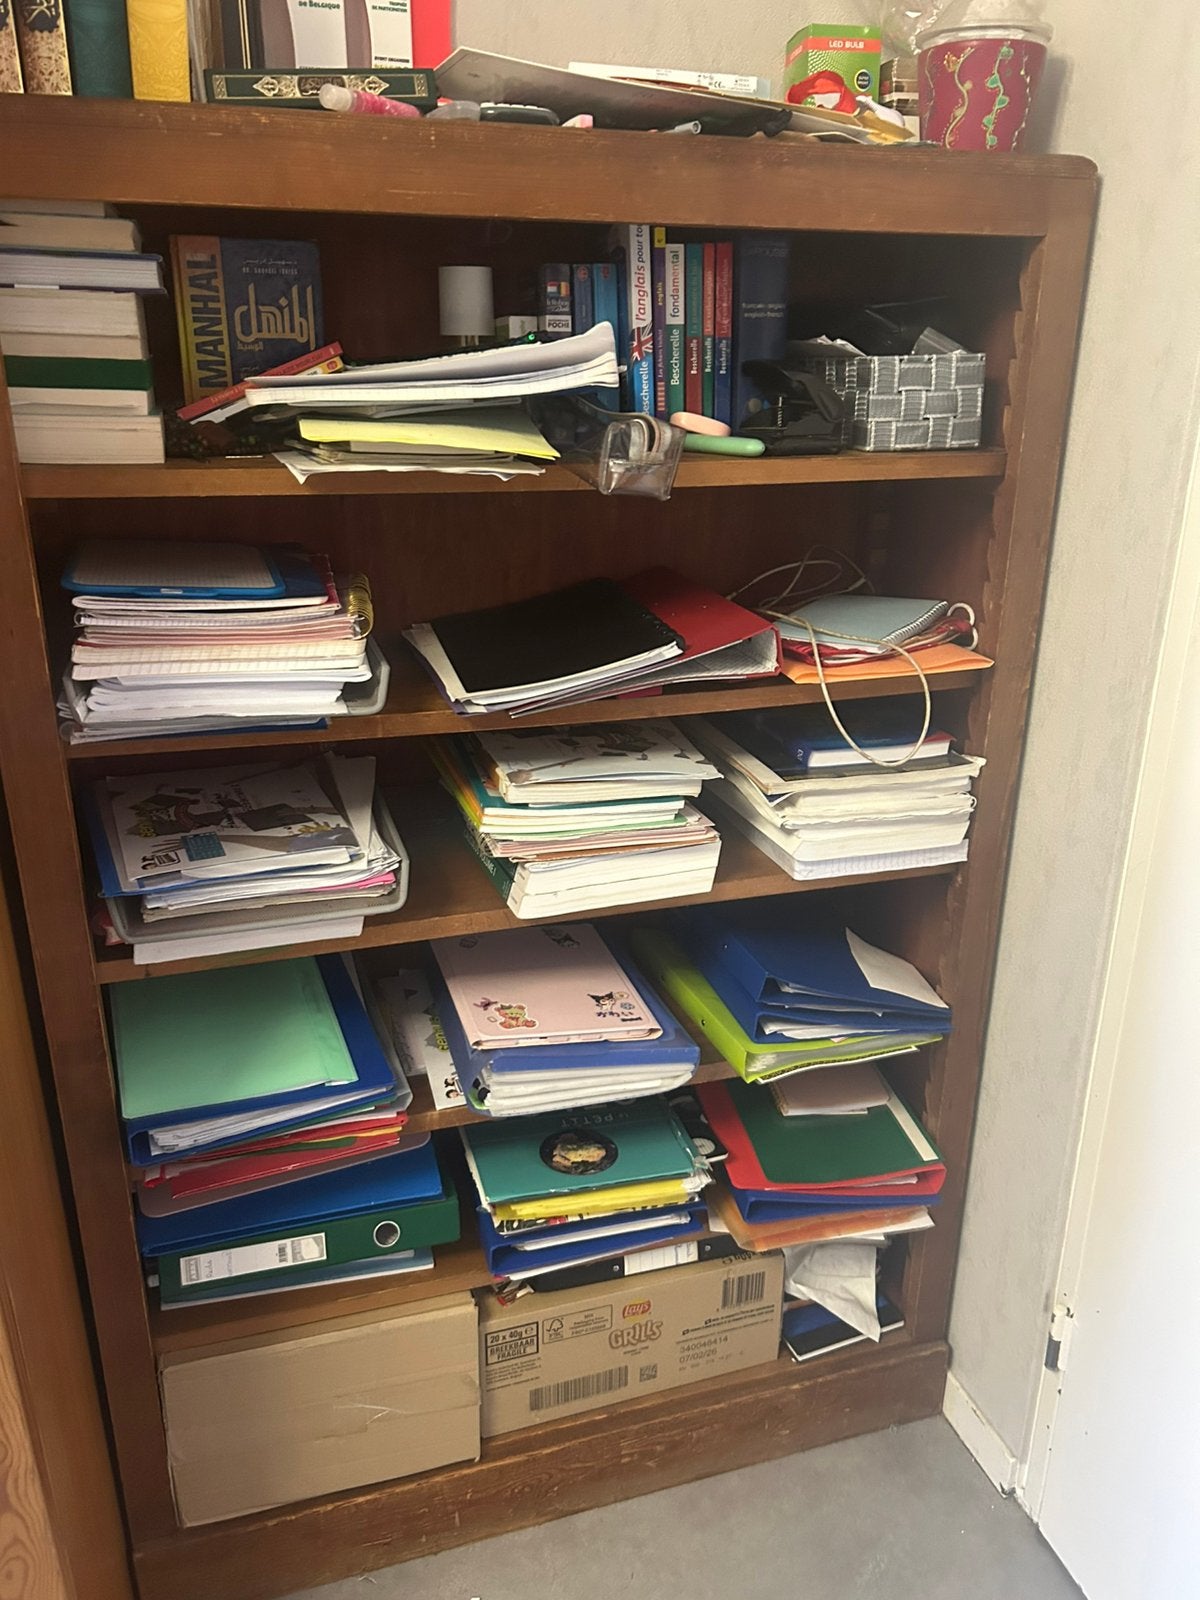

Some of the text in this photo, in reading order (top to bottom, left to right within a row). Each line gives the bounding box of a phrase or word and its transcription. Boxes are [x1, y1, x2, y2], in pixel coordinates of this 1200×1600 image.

[829, 40, 864, 49] LED BULB
[634, 224, 649, 321] l'anglais pour to
[670, 250, 680, 318] fondamental
[187, 254, 228, 388] MANHAL
[670, 328, 680, 386] Bescherelle
[690, 338, 698, 375] Bescherelle
[704, 337, 712, 373] Bescherelle
[719, 339, 727, 375] Bescherelle
[489, 1338, 535, 1357] BREEKBAAR
[490, 1333, 500, 1344] 20
[509, 1329, 523, 1340] 40g
[497, 1347, 528, 1361] FRAGILE
